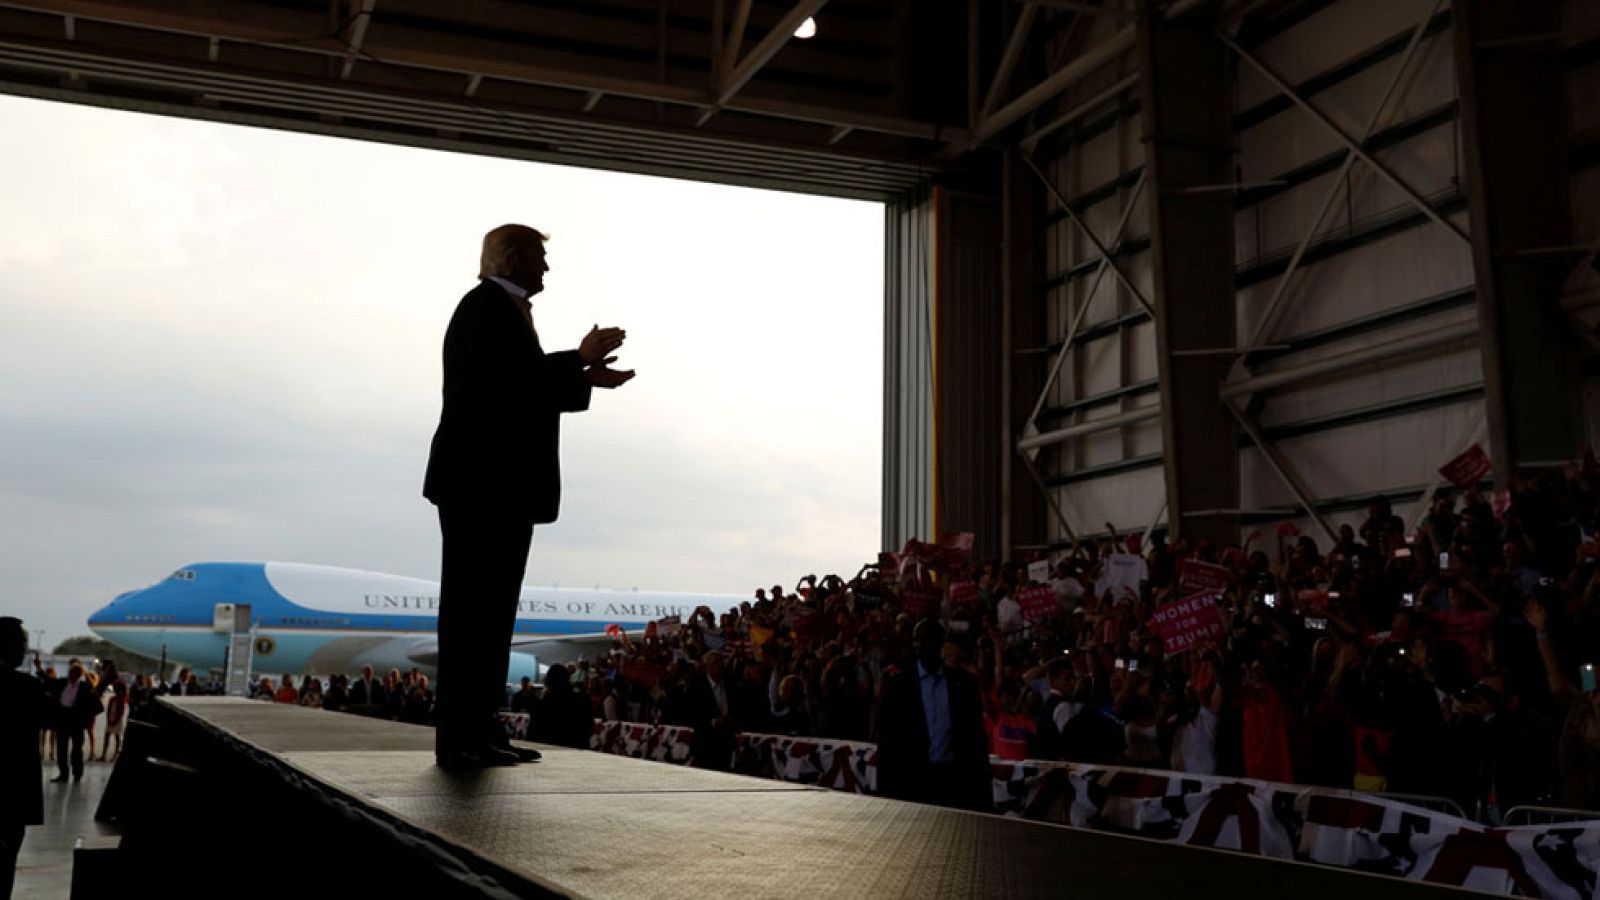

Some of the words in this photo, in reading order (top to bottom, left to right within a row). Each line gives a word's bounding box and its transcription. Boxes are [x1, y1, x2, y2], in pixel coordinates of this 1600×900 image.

[364, 594, 440, 609] UNITE
[516, 600, 558, 613] TES
[567, 602, 597, 615] OF
[603, 603, 690, 617] AMERIC
[1153, 594, 1215, 623] WOMEN
[1176, 616, 1197, 630] FOR
[1167, 623, 1220, 648] TRUMP
